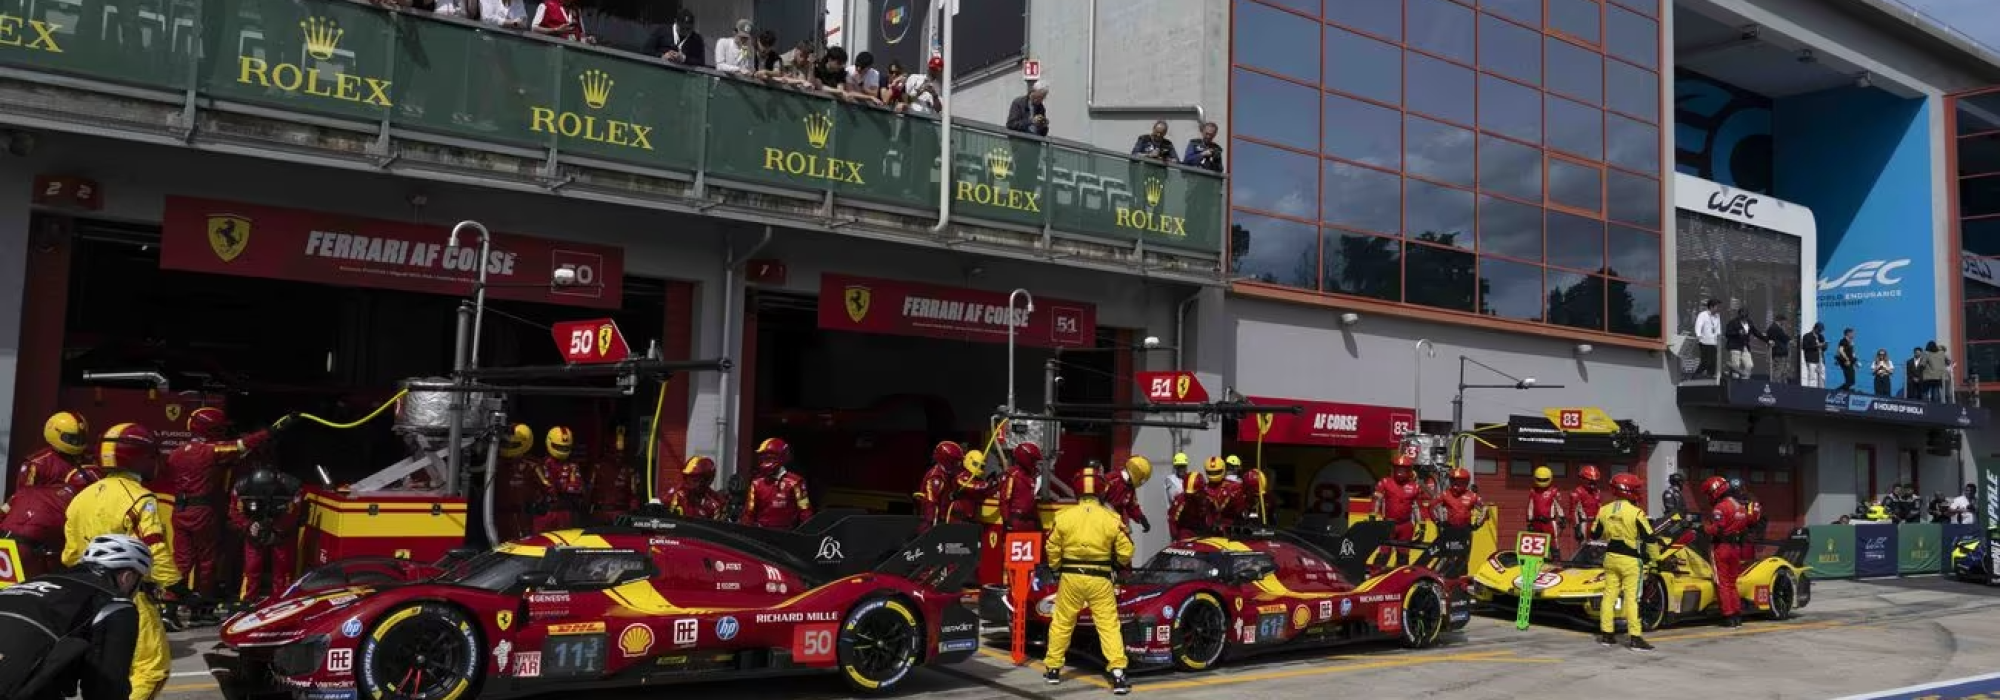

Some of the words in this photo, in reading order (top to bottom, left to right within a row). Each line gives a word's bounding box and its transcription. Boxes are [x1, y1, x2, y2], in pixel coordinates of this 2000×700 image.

[0, 17, 63, 53] EX
[237, 55, 394, 107] ROLEX
[530, 106, 654, 151] ROLEX
[764, 147, 866, 185] ROLEX
[956, 181, 1041, 213] ROLEX
[1707, 191, 1758, 219] WEC
[1116, 206, 1187, 237] ROLEX
[304, 230, 409, 264] FERRARI
[409, 242, 441, 268] AF
[1818, 293, 1843, 302] ORLD
[1845, 289, 1902, 300] ENDURANCE
[902, 296, 963, 321] FERRARI
[964, 303, 985, 324] AF
[1056, 316, 1078, 333] 51
[569, 329, 594, 355] 50
[1150, 378, 1172, 398] 51
[1313, 413, 1327, 430] AF
[1327, 414, 1358, 432] CORSE
[1562, 412, 1579, 427] 83
[1011, 540, 1035, 562] 51
[1520, 536, 1546, 553] 83
[534, 594, 571, 603] GENESYS
[1360, 595, 1384, 603] RICHARD
[756, 614, 803, 623] RICHARD
[807, 611, 838, 620] MILLE
[1384, 607, 1398, 625] 51
[718, 617, 738, 640] hp
[804, 629, 832, 655] 50
